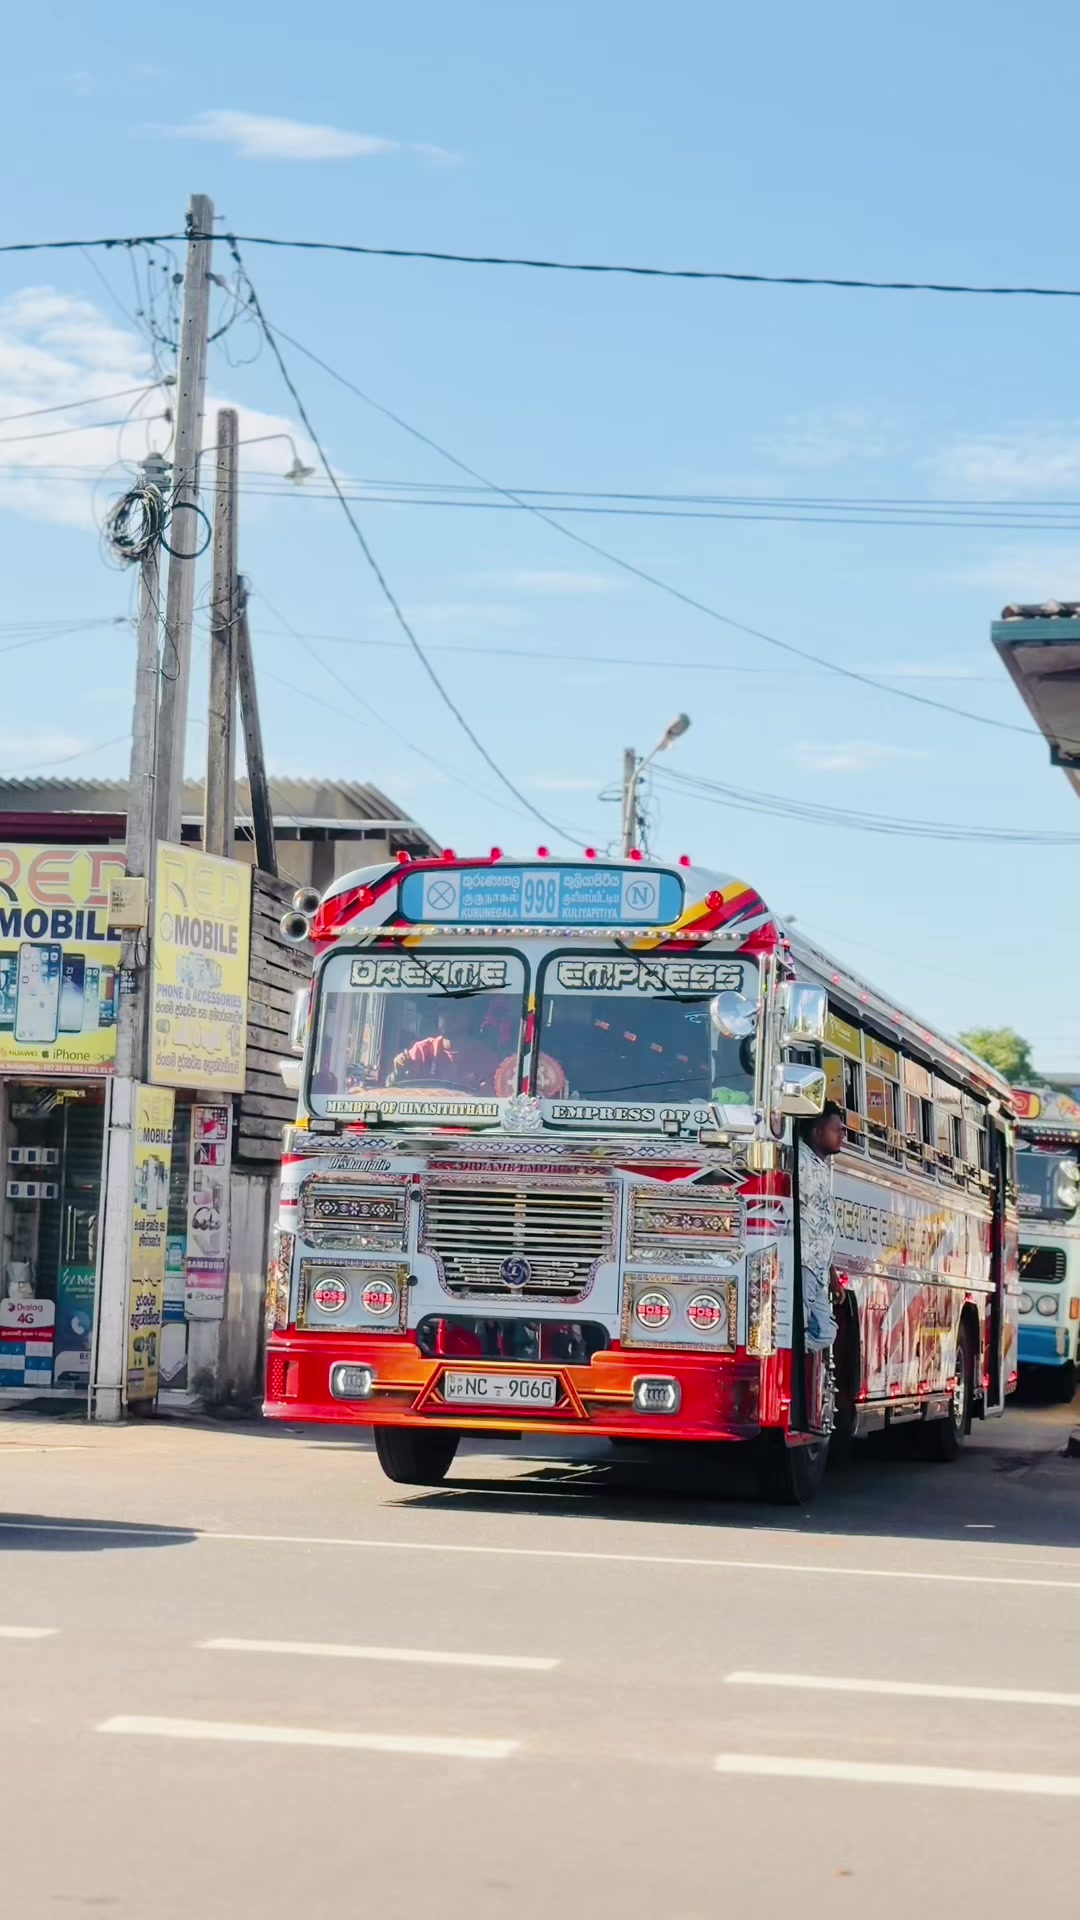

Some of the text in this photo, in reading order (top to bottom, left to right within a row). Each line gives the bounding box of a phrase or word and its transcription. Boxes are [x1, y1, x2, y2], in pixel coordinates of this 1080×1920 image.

[525, 878, 556, 914] 998
[632, 886, 648, 905] N
[461, 906, 519, 919] KURUNEGALA
[562, 907, 618, 919] KULIYAPITIYA
[174, 914, 238, 955] MOBILE
[558, 961, 744, 993] EMPRESS
[157, 984, 242, 1009] PHONE & ACCESSORIES
[53, 1048, 90, 1061] iPhone
[327, 1101, 378, 1113] MEMBER
[382, 1102, 397, 1115] OF
[552, 1105, 655, 1122] EMPRESS
[659, 1109, 690, 1123] OF
[143, 1127, 172, 1144] MOBILE
[195, 1292, 222, 1301] iPhone
[315, 1291, 345, 1300] BOSS
[363, 1293, 393, 1302] BOSS
[17, 1303, 43, 1312] Dialog
[638, 1306, 669, 1315] BOSS
[688, 1308, 720, 1317] BOSS
[17, 1313, 34, 1324] 4G
[465, 1378, 488, 1396] NC
[509, 1380, 552, 1399] 9060
